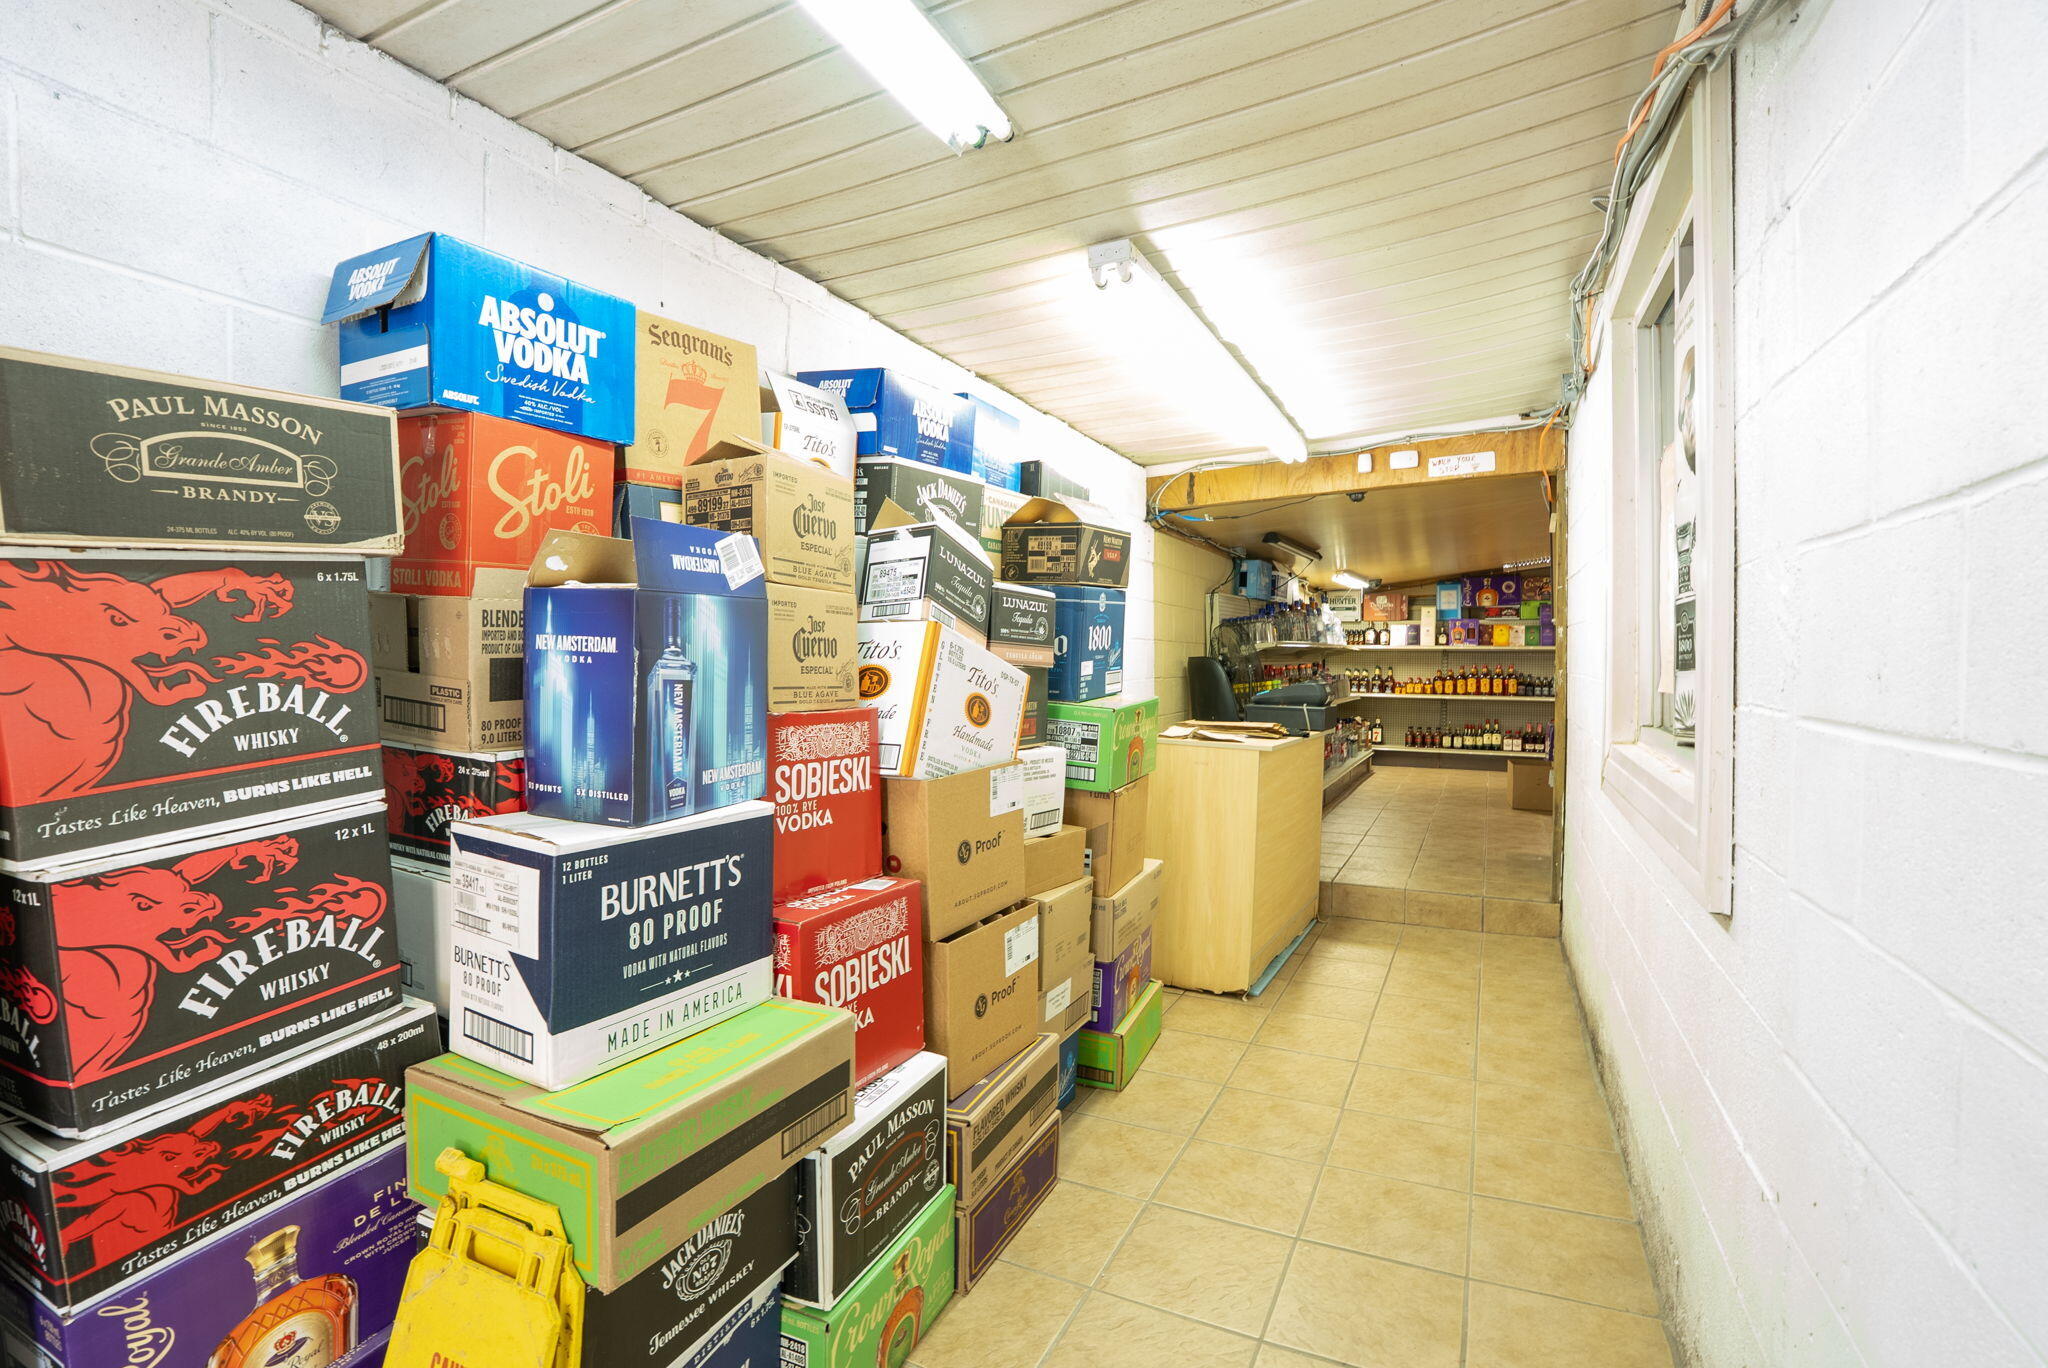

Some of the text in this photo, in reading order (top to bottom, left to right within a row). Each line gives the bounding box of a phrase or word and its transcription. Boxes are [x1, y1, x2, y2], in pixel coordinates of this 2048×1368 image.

[348, 258, 400, 286] ABSOLUT
[349, 276, 386, 300] VODKA
[478, 295, 602, 358] ABSOLUT
[492, 329, 590, 384] VODKA
[648, 324, 733, 367] Seagram's
[485, 364, 550, 393] Swedish
[552, 380, 597, 405] Vodka
[819, 379, 853, 388] ABSOLUT
[107, 395, 324, 445] PAUL MASSON
[664, 372, 725, 467] 7
[917, 416, 950, 442] VODKA
[803, 435, 837, 457] Tito's
[154, 443, 293, 476] Grande Amber
[715, 472, 734, 484] Cuervo
[773, 471, 798, 484] IMPORTED
[182, 486, 279, 504] BRANDY
[487, 445, 595, 539] Stoli
[698, 497, 722, 512] 89199
[808, 493, 825, 513] Jose
[917, 482, 936, 506] JACK
[938, 478, 967, 516] DANIEL'S
[793, 504, 836, 540] Cuervo
[801, 542, 832, 555] ESPECIAL
[317, 571, 359, 582] 6 1.75L
[393, 567, 462, 588] STOLI VODKA
[793, 566, 836, 579] BLUE AGAVE
[939, 545, 986, 588] LUNAZUL
[951, 575, 973, 598] Tequila
[772, 600, 797, 608] IMPORTED
[1002, 597, 1048, 613] LUNAZUL
[1330, 597, 1356, 605] HUNTER
[808, 615, 825, 635] Jose
[1012, 612, 1033, 627] Tequila
[481, 630, 517, 641] IMPORTED AND
[536, 635, 617, 653] NEW AMSTERDAM
[793, 627, 837, 663] Cuervo
[1088, 625, 1112, 651] 1800
[481, 643, 510, 655] PRODUCT OF
[556, 654, 593, 664] VODKA
[801, 666, 833, 674] ESPECIAL
[967, 666, 999, 696] Tito's
[431, 686, 461, 698] PLASTIC
[158, 682, 352, 759] FIREBALL
[481, 718, 522, 732] 80 PROOF
[672, 683, 684, 773] NEW AMSTERDAM
[233, 727, 300, 752] WHISKY
[481, 731, 522, 744] 9.0 LITERS
[952, 724, 993, 753] Handmade
[702, 760, 762, 784] NEW AMSTERDAM
[775, 755, 870, 805] SOBIESKI
[536, 783, 562, 794] POINTS
[576, 788, 628, 801] 5X DISTILLED
[668, 786, 685, 798] VODKA
[37, 766, 372, 839] Tastes Like Heaven, BURNS LIKE HELL
[776, 801, 817, 817] 100% RYE
[335, 822, 375, 841] 12 1L
[775, 808, 833, 835] VODKA
[416, 847, 435, 859] NATURAL
[975, 831, 1002, 855] Proof
[562, 854, 609, 872] 12 BOTTLES
[570, 870, 593, 883] LITER
[601, 855, 742, 922] BURNETT'S
[629, 899, 723, 950] 80 PROOF
[178, 914, 385, 1020] FIREBALL
[454, 946, 511, 982] BURNETT'S
[623, 932, 728, 980] VODKA WITH NATURAL FLAVORS
[259, 963, 330, 1001] WHISKY
[463, 971, 502, 996] 80 PROOF
[815, 935, 912, 1009] SOBIESKI
[992, 977, 1017, 1006] Proof
[607, 981, 743, 1053] MADE IN AMERICA
[91, 987, 394, 1111] Tastes Like Heaven, BURNS LIKE HELL
[377, 1024, 425, 1051] 48 200ml
[973, 1099, 1004, 1139] FLAVORED
[1005, 1075, 1028, 1106] WHISKY
[271, 1082, 402, 1162] FIREBALL
[320, 1115, 366, 1146] WHISKY
[847, 1100, 935, 1183] PAUL MASSON
[121, 1137, 379, 1275] Tastes Like Heaven, BURNS LIKE
[876, 1177, 916, 1221] BRANDY
[354, 1205, 381, 1228] DE
[388, 1219, 404, 1232] 750
[333, 1218, 379, 1253] Blended
[364, 1227, 416, 1259] WITH CROWN
[420, 1230, 428, 1238] 24
[344, 1230, 403, 1265] CROWN ROYAL
[660, 1237, 697, 1290] JACK
[697, 1209, 745, 1250] DANIEL'S
[831, 1217, 952, 1368] Crown Royal
[649, 1303, 706, 1355] Tennessee
[708, 1259, 755, 1304] WHISKEY
[693, 1302, 751, 1365] DISTILLED
[750, 1318, 756, 1328] 6
